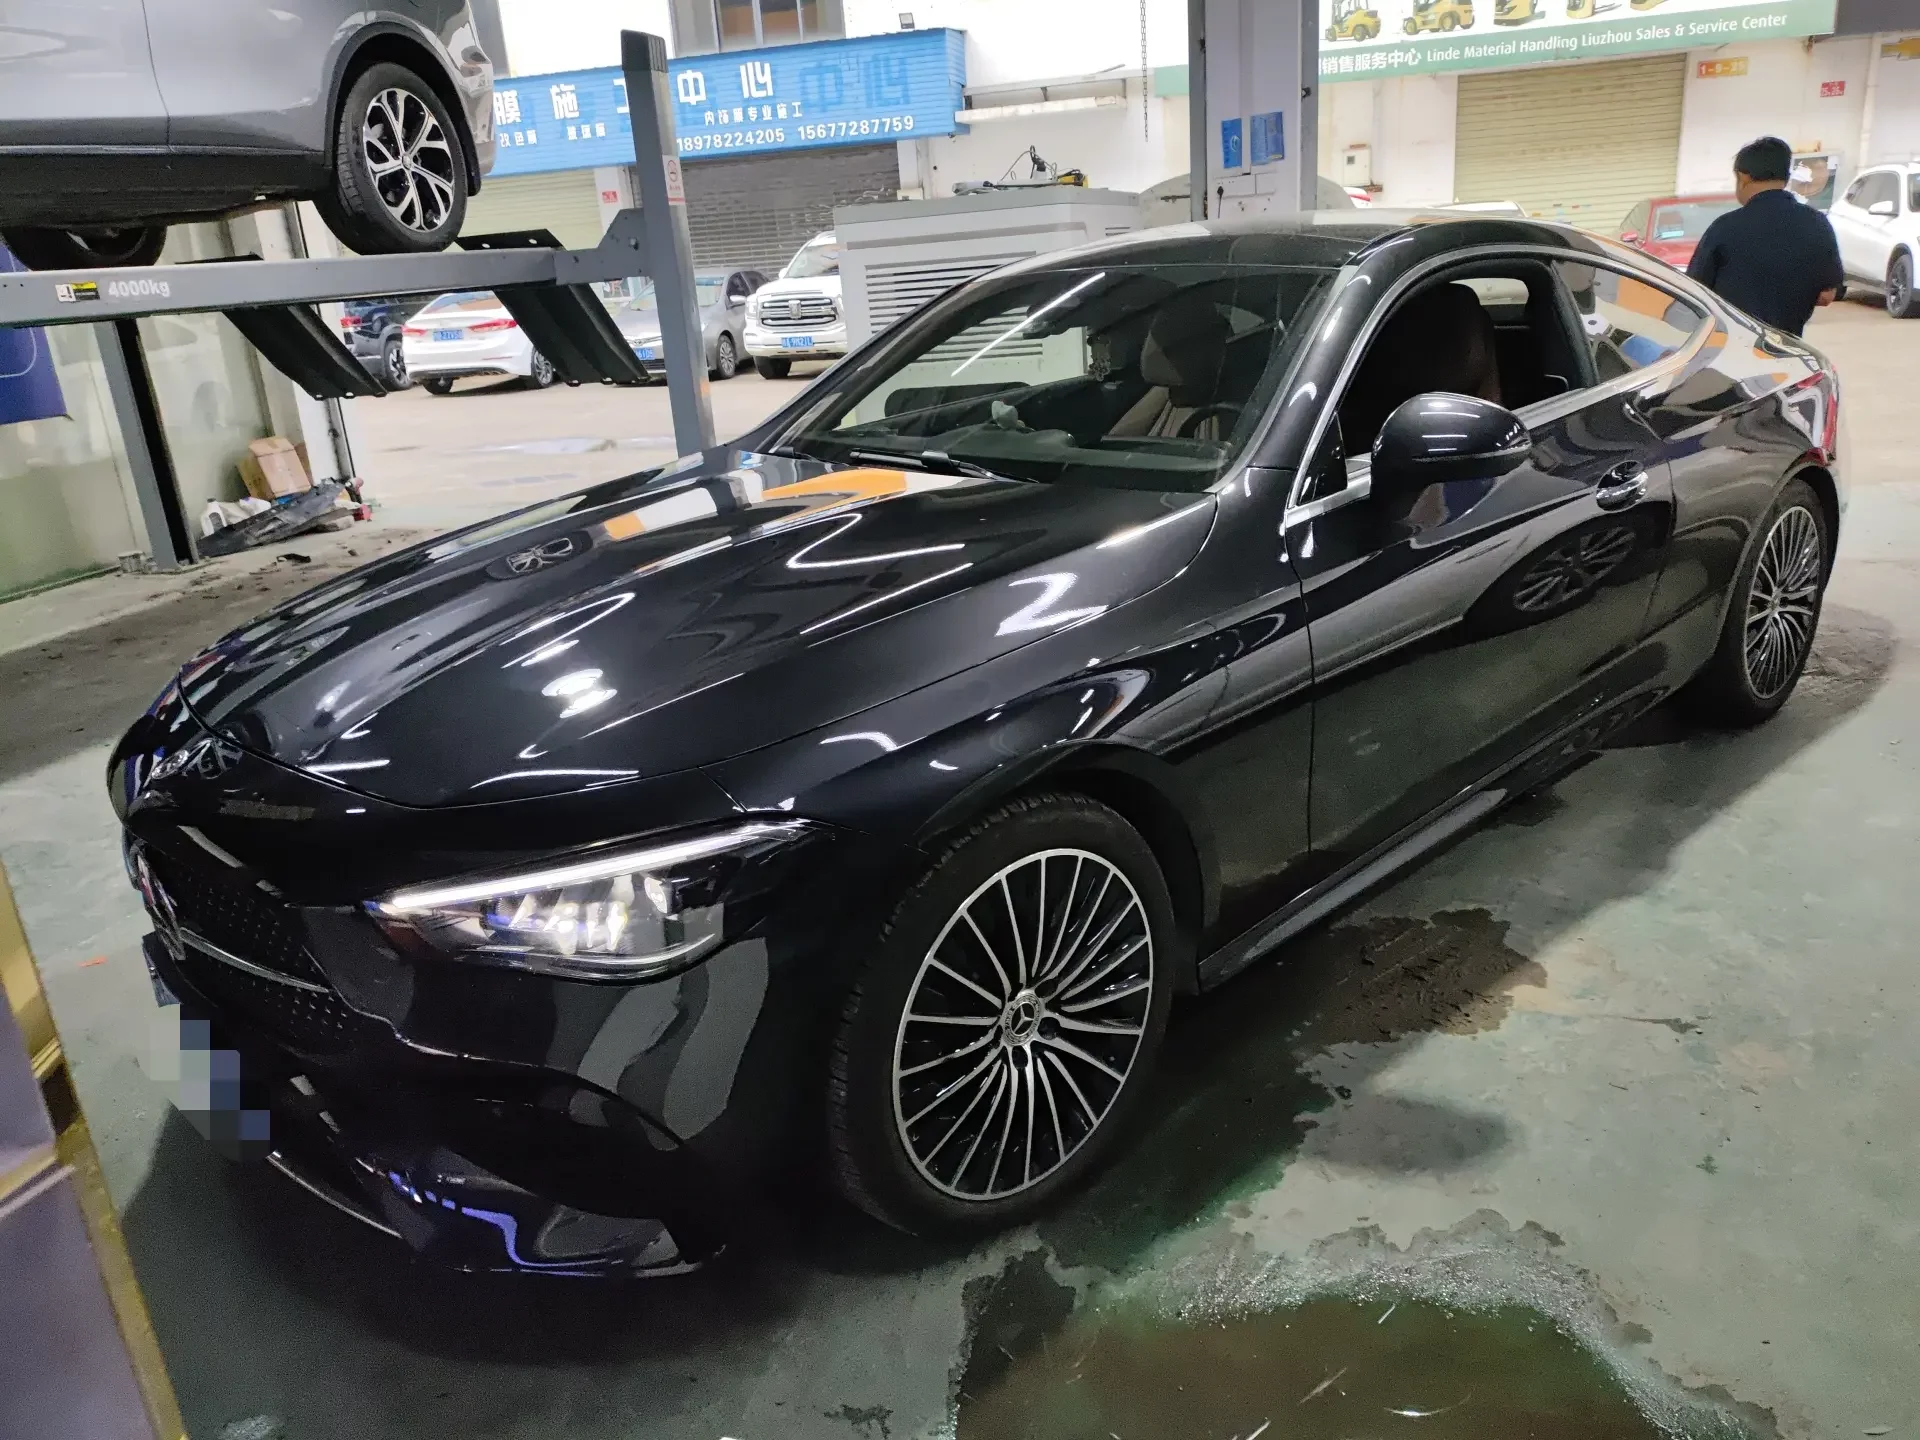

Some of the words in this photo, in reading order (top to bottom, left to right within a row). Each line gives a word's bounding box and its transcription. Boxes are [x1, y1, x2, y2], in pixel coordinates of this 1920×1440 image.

[1427, 46, 1461, 62] Linde
[1463, 41, 1516, 59] Material
[1519, 36, 1578, 53] Handling
[1581, 30, 1632, 46] Liuzhou
[1636, 25, 1671, 41] Sales
[1674, 24, 1685, 36] &
[1688, 19, 1738, 36] Service
[1742, 14, 1788, 29] Center
[1319, 47, 1422, 76] 销售服务中心
[676, 127, 786, 152] 18978224205
[797, 115, 914, 141] 15677287759
[108, 279, 170, 298] 4000kg
